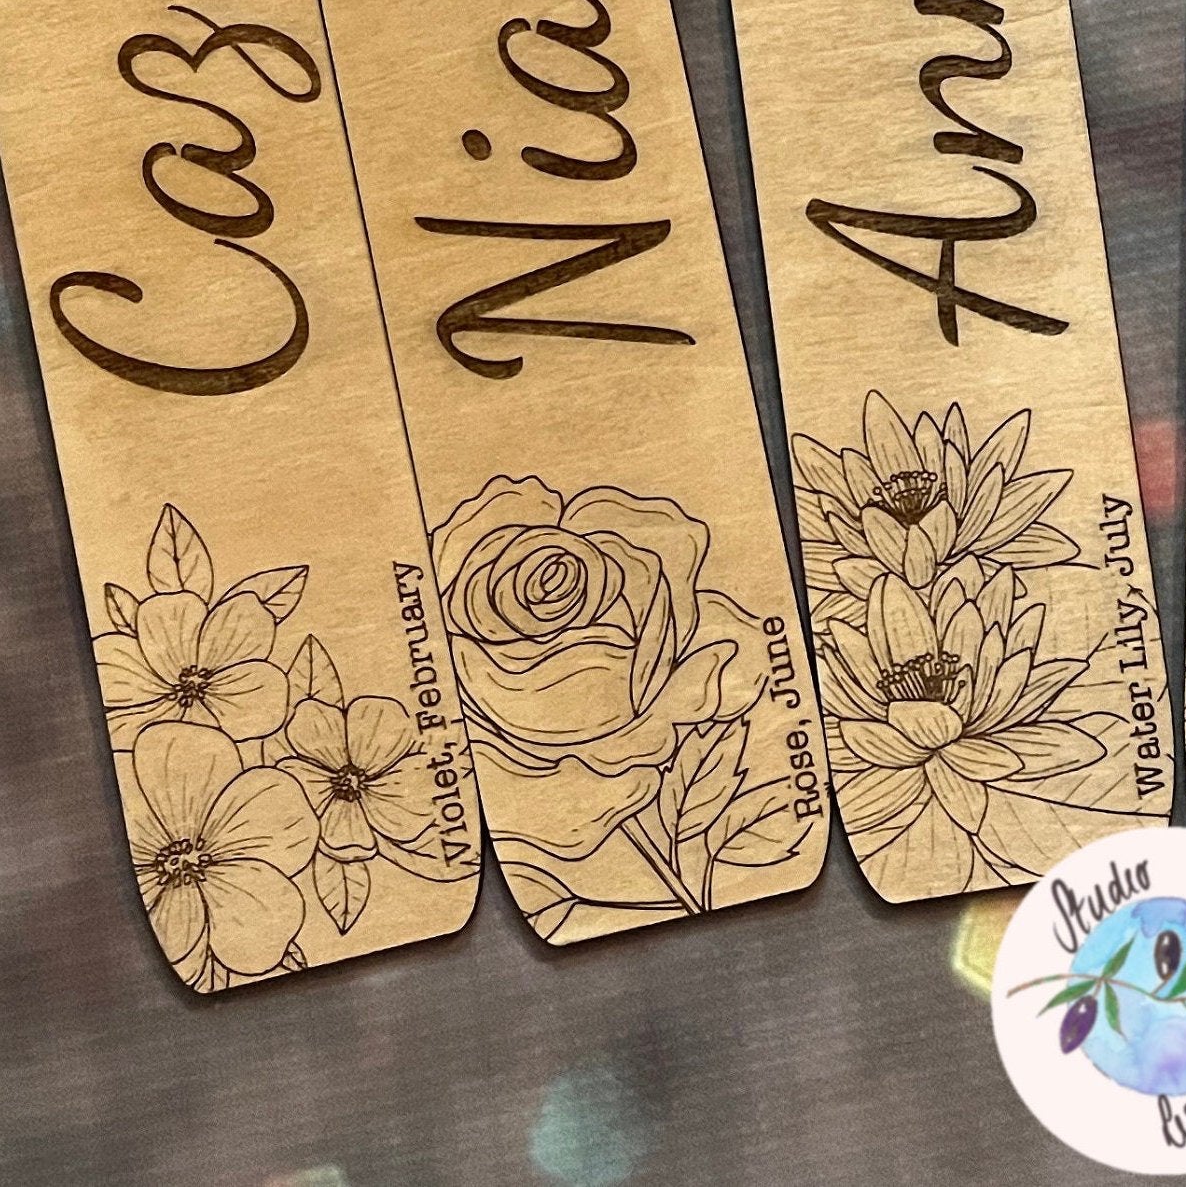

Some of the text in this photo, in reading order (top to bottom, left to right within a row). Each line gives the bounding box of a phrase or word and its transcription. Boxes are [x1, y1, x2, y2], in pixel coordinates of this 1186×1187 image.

[49, 5, 322, 397] Caz
[392, 560, 447, 735] February
[762, 615, 824, 823] Rose, June
[1099, 493, 1166, 801] Water Lily, July
